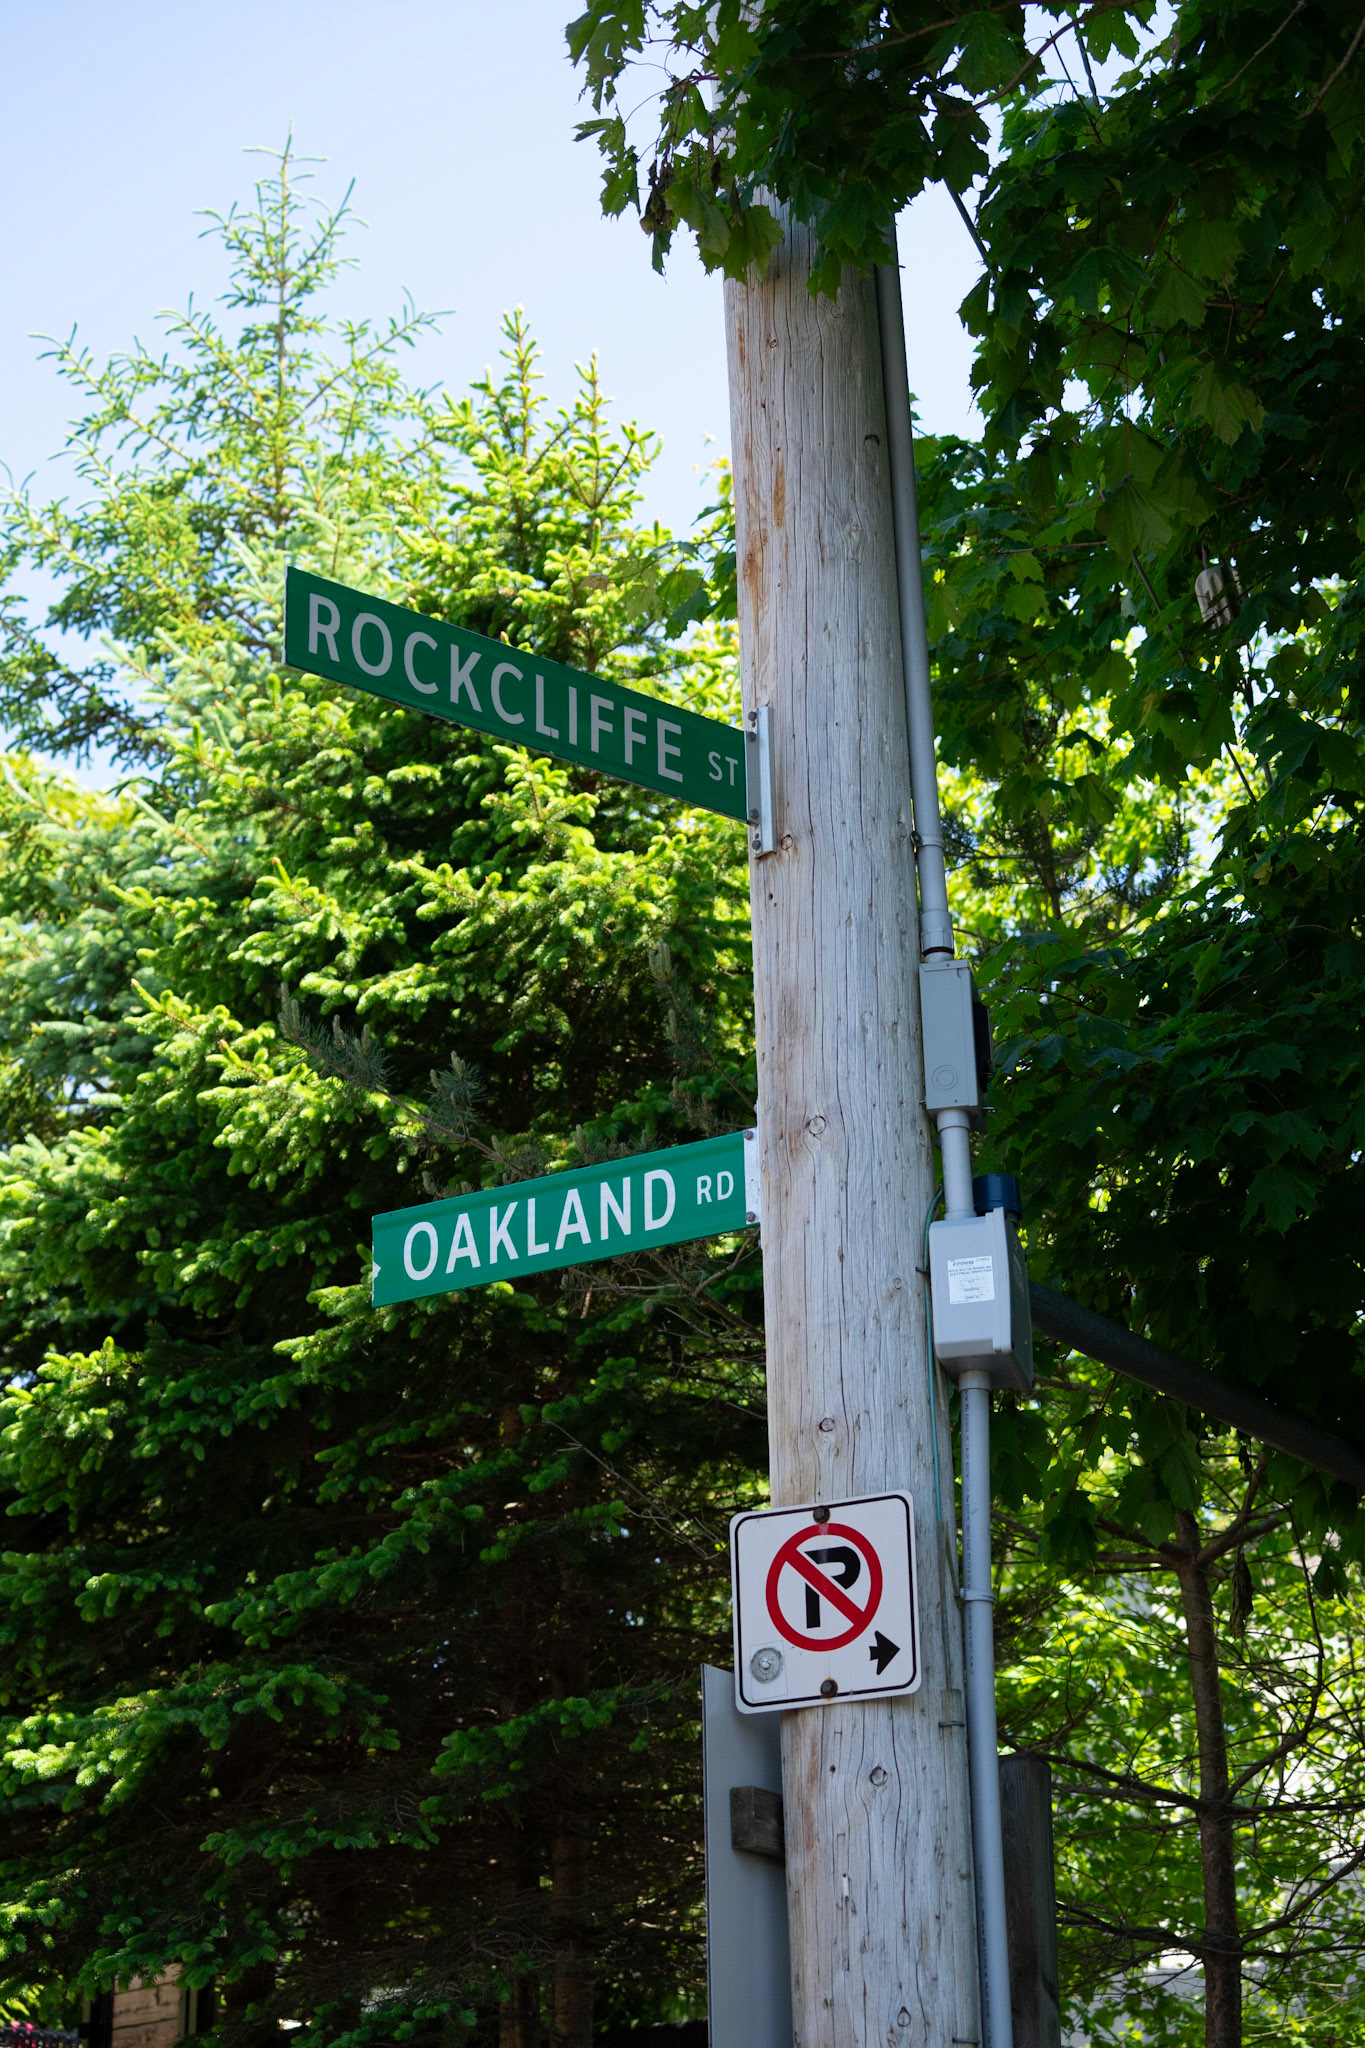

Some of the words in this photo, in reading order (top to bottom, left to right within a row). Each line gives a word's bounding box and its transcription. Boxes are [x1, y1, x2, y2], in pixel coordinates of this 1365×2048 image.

[308, 593, 684, 783] ROCKCLIFFE
[709, 752, 739, 786] ST
[403, 1169, 676, 1281] OAKLAND
[696, 1171, 734, 1204] RD
